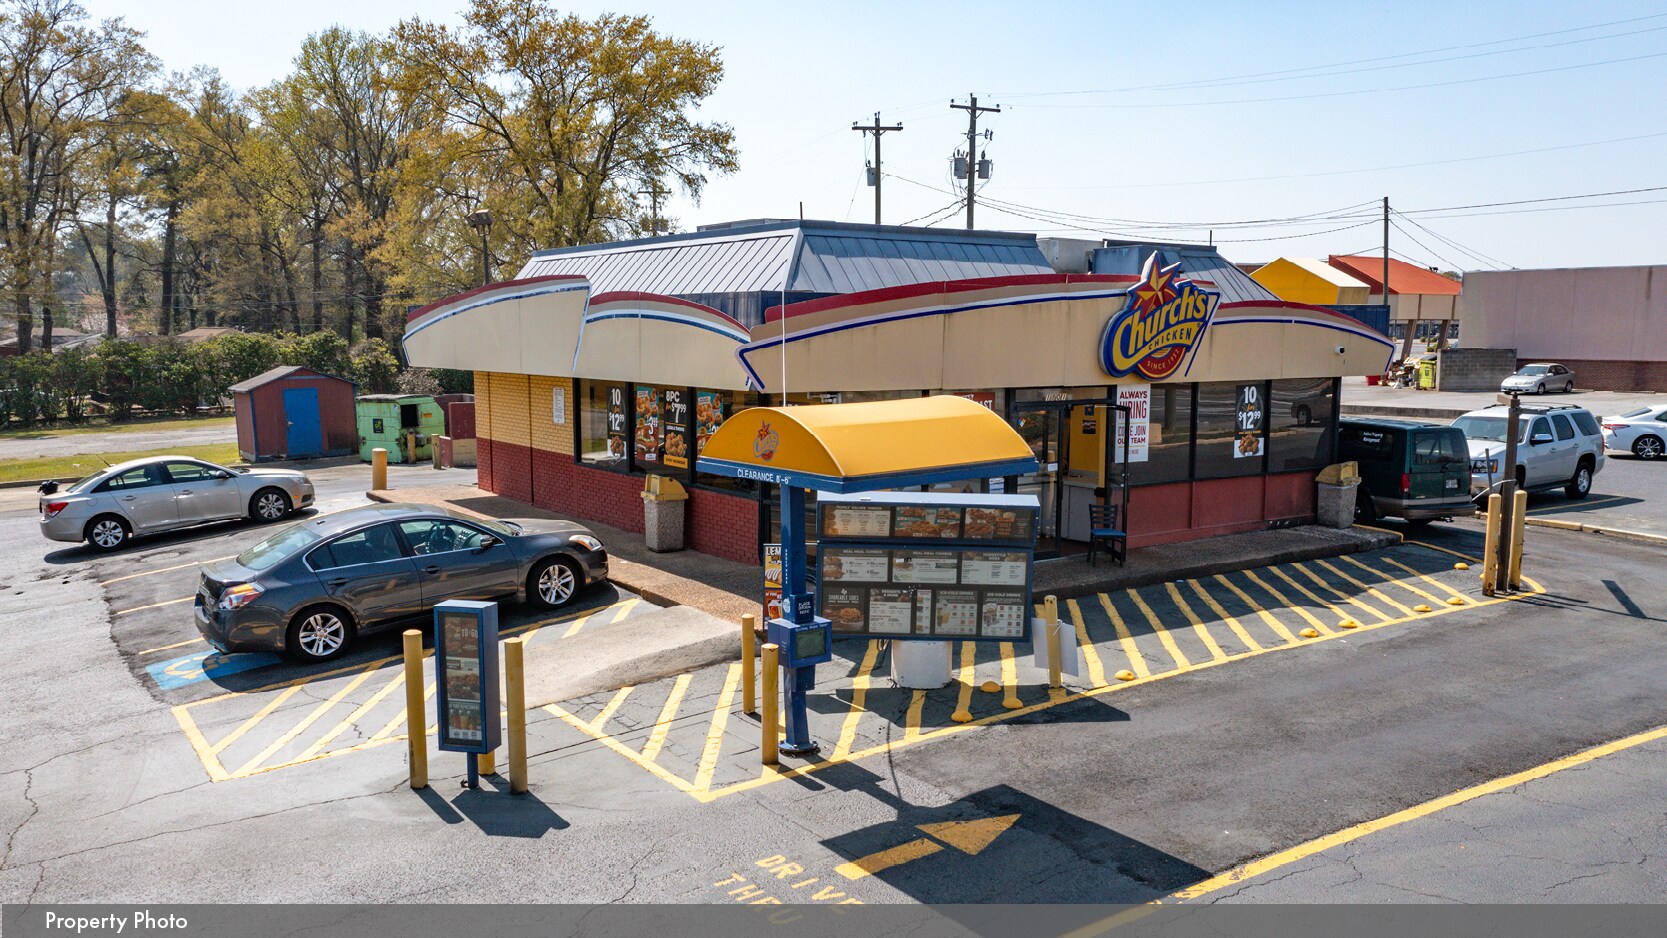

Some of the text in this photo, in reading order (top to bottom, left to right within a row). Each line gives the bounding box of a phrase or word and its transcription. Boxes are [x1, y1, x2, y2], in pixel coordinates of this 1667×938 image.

[1113, 286, 1206, 370] Church's
[1148, 328, 1192, 350] CHICKEN
[1147, 350, 1180, 370] SINCE 1952
[612, 388, 621, 405] 10
[666, 391, 680, 402] 8PC
[1244, 386, 1257, 404] 10
[1118, 426, 1146, 436] COE JOIN
[738, 468, 773, 482] CLEARANCE
[755, 854, 866, 914] DRIVE
[714, 872, 803, 924] THRU
